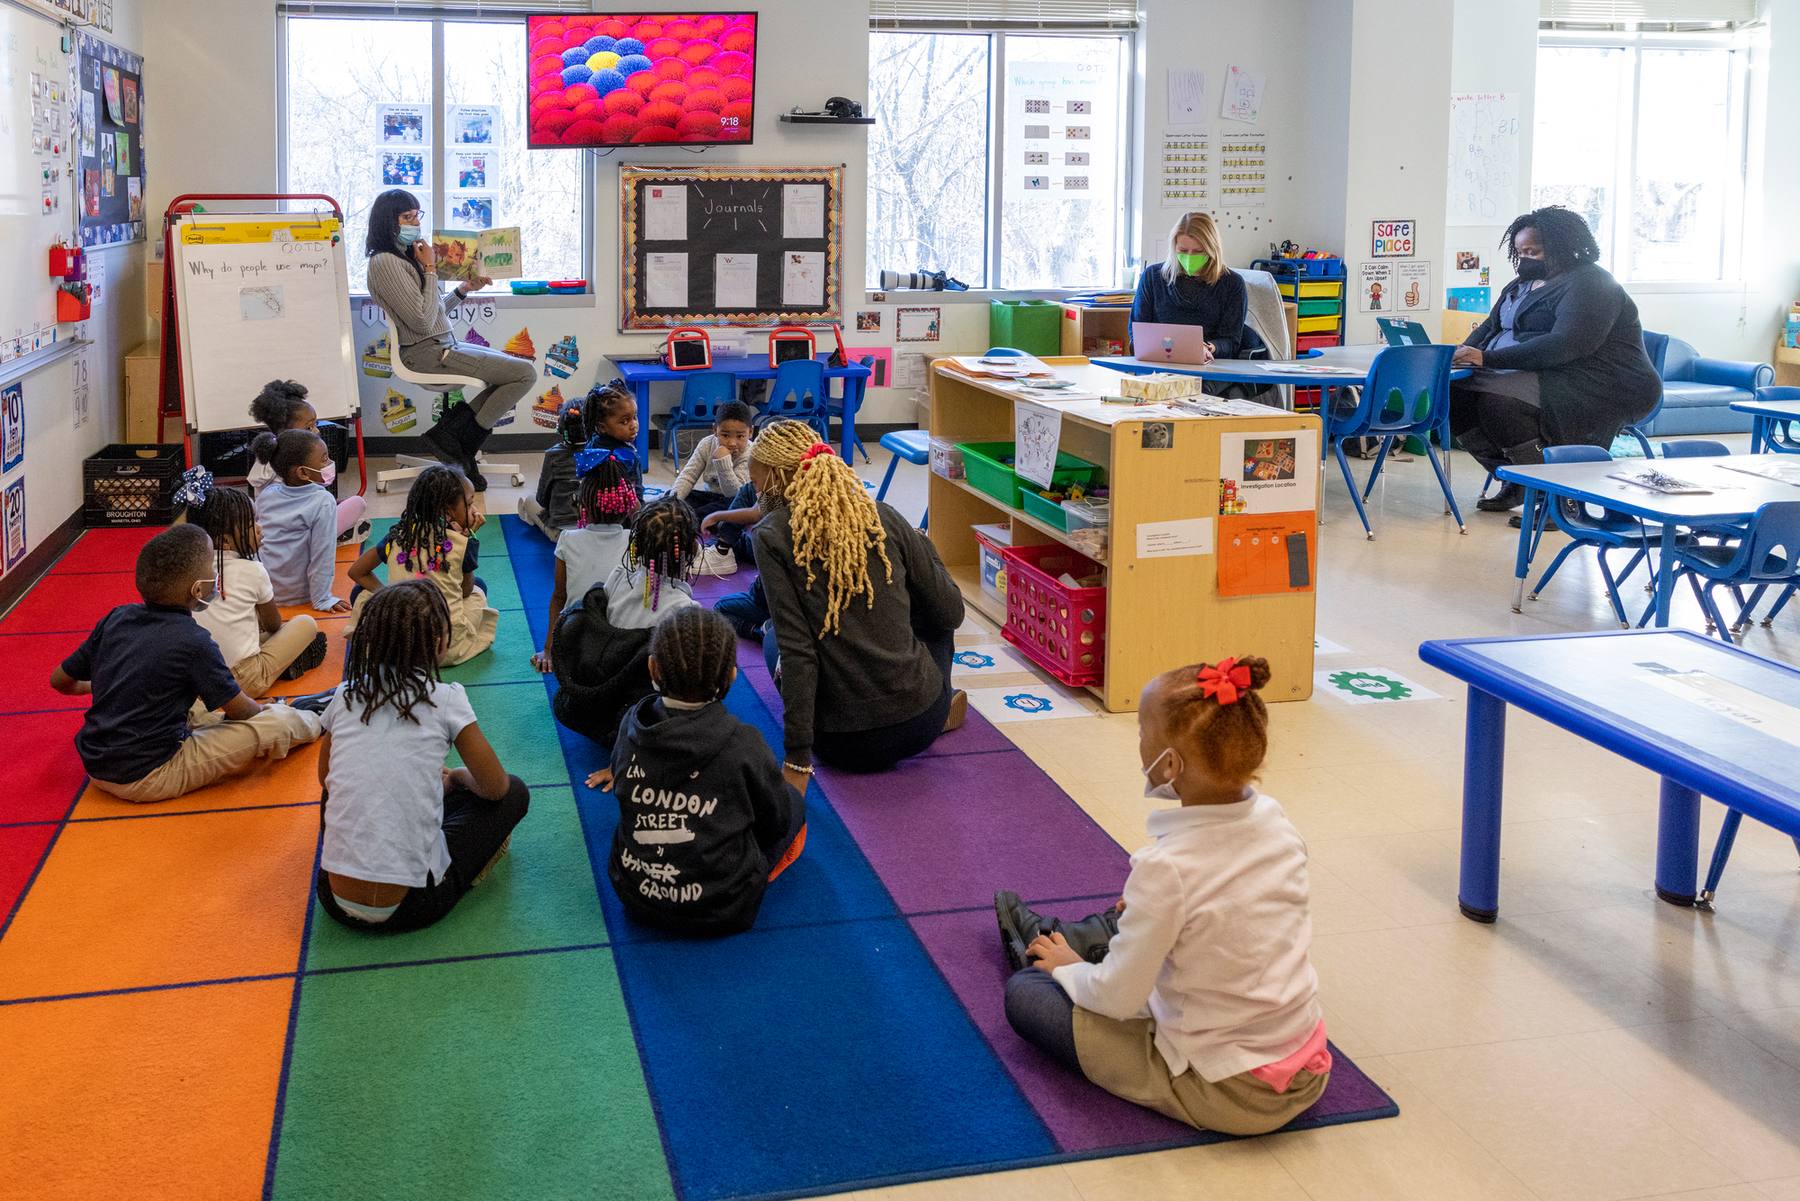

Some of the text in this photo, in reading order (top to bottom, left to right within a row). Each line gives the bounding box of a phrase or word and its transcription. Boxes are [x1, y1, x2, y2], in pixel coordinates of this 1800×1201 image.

[720, 117, 738, 126] 9:18
[704, 199, 763, 215] Journals
[188, 258, 328, 280] Why do people use maps?
[8, 392, 19, 425] 10
[9, 488, 20, 519] 20
[631, 784, 718, 818] LONDON
[634, 813, 689, 830] STREET
[639, 878, 703, 903] GROUND
